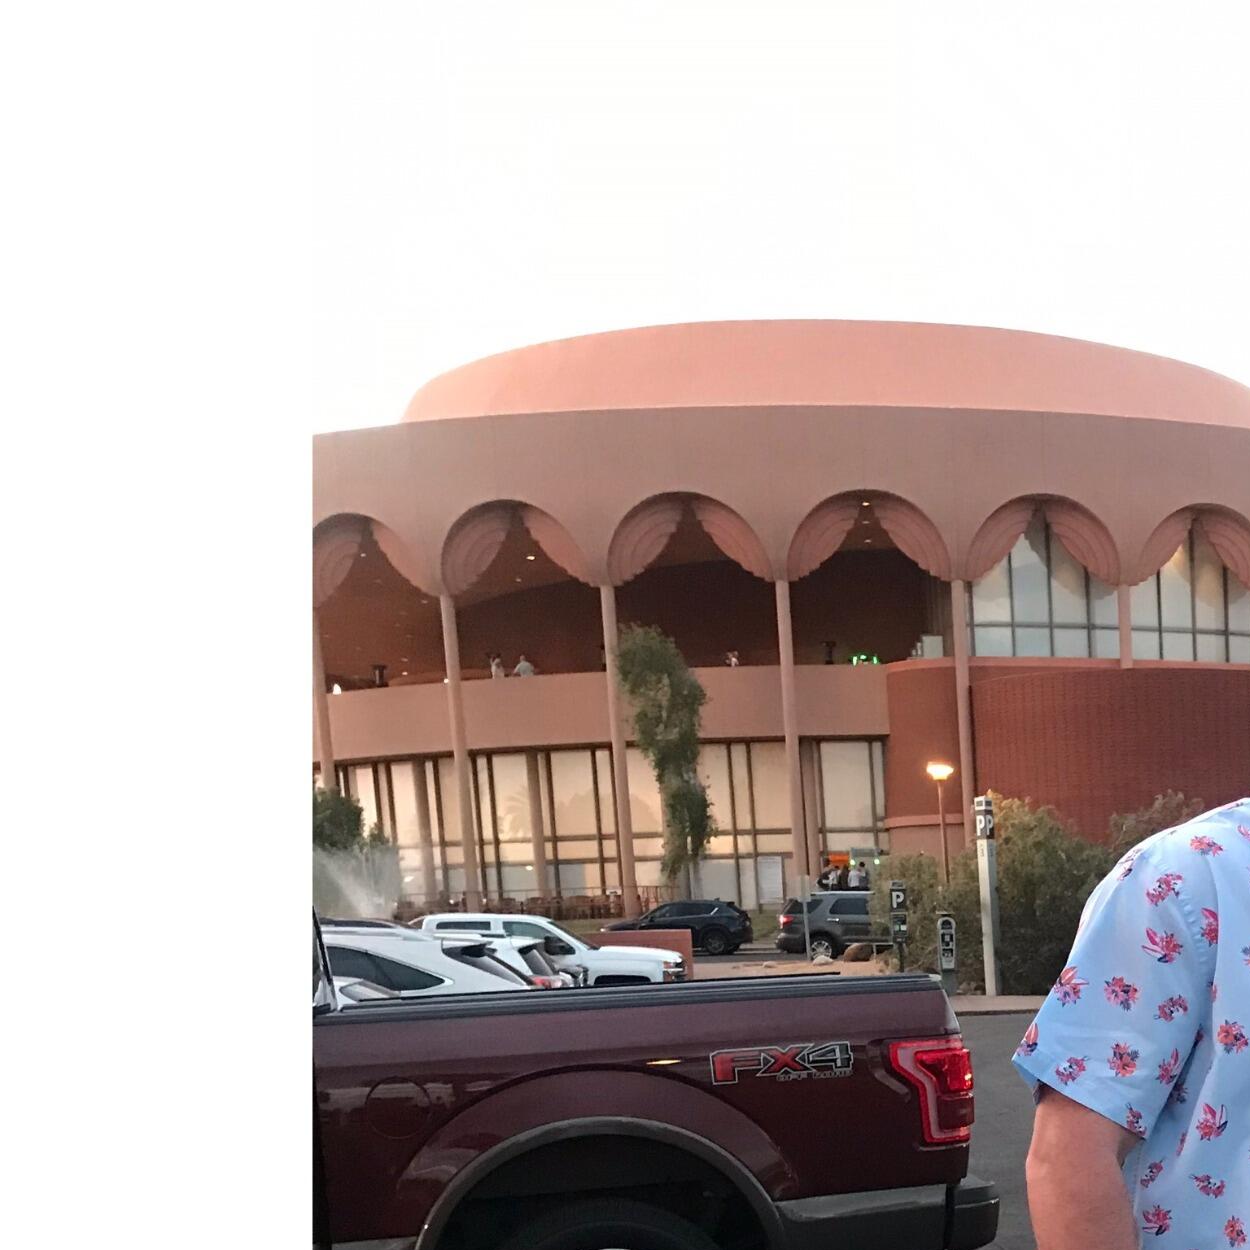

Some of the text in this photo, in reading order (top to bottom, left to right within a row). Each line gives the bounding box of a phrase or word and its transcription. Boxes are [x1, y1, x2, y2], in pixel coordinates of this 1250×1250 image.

[976, 815, 986, 836] P
[986, 815, 994, 836] P
[891, 891, 905, 909] P
[709, 1041, 854, 1085] FX4
